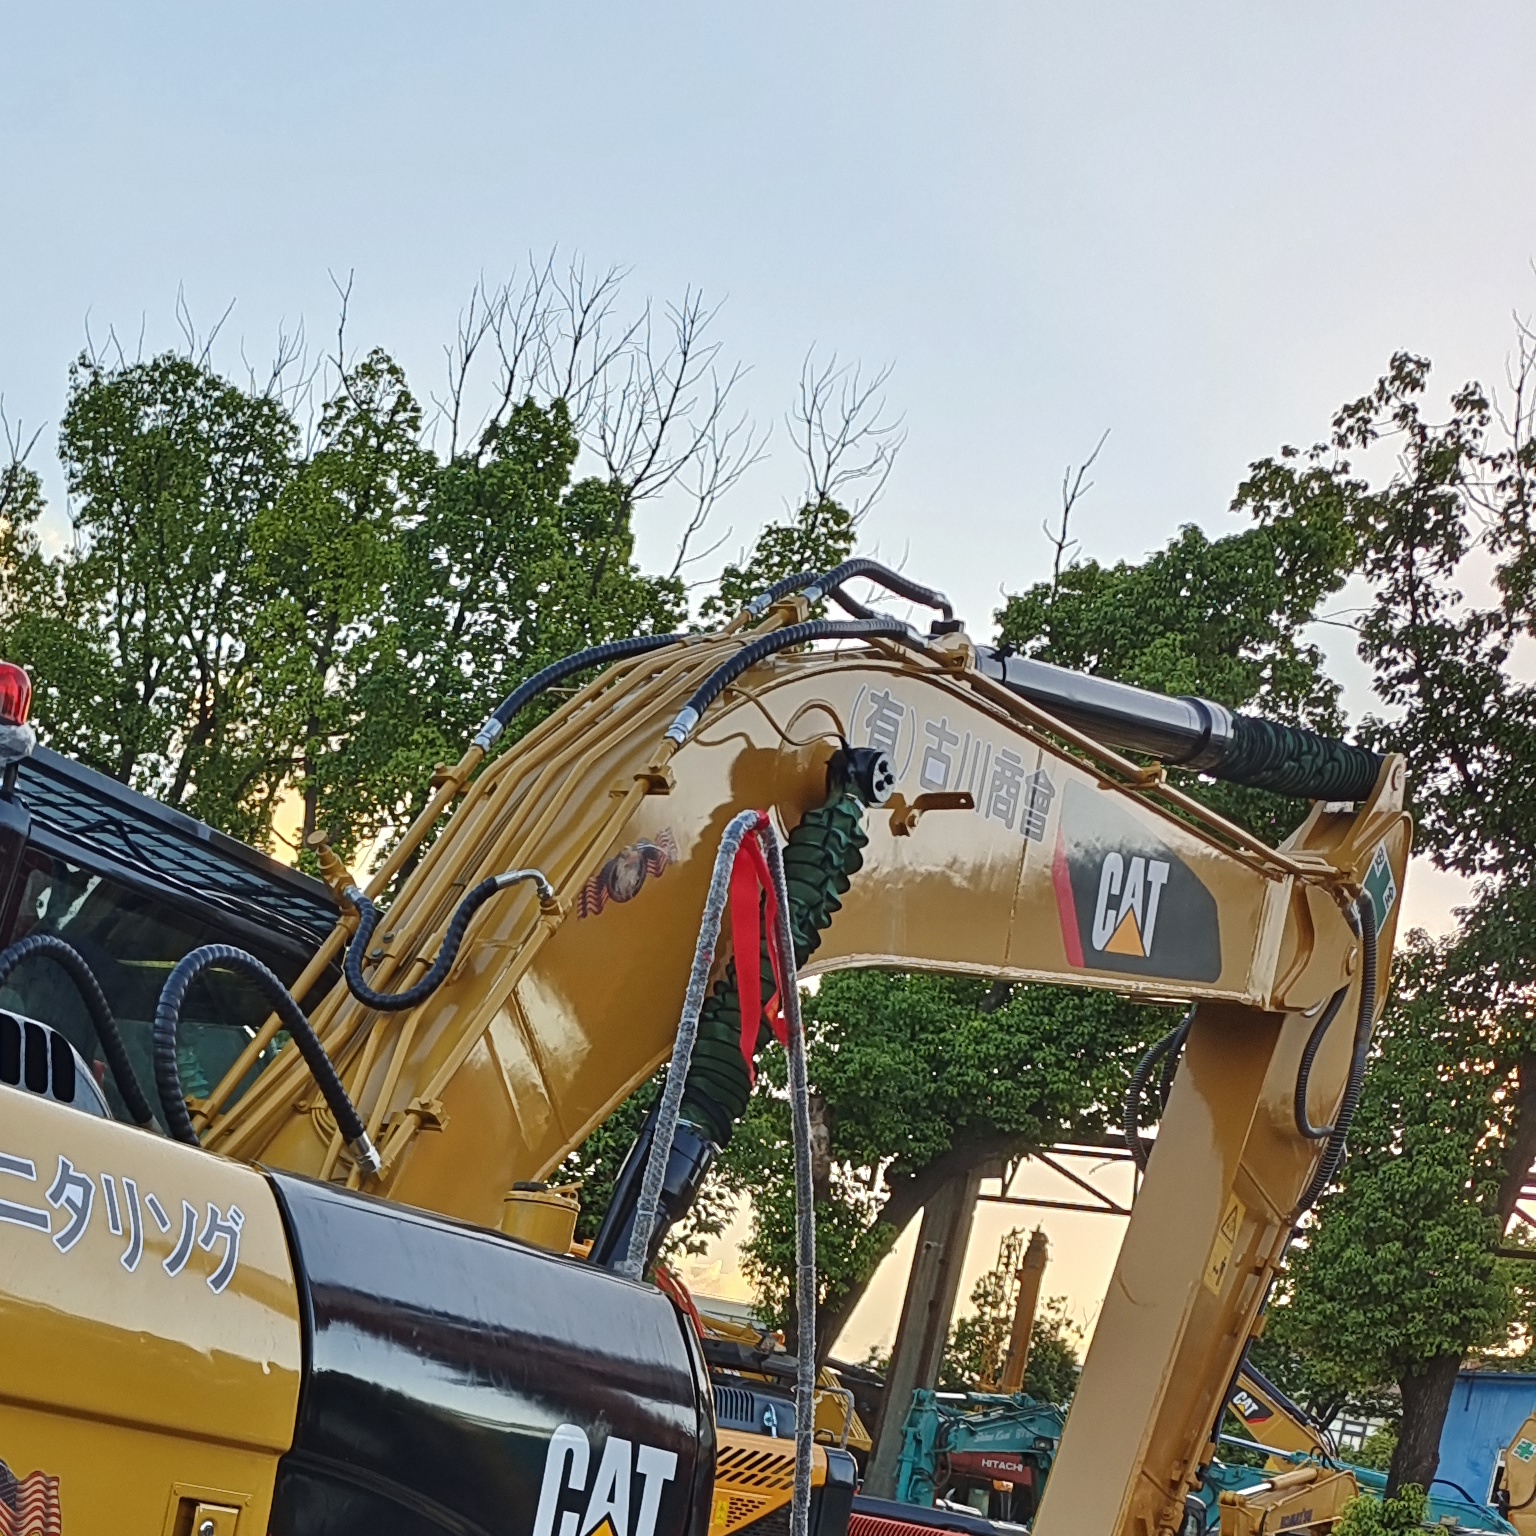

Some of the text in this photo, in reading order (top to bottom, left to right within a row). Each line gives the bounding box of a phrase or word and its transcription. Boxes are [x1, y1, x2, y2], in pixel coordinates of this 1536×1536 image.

[1092, 851, 1170, 958] CAT
[1232, 1391, 1260, 1418] CAT
[981, 1459, 1024, 1473] HITACHI
